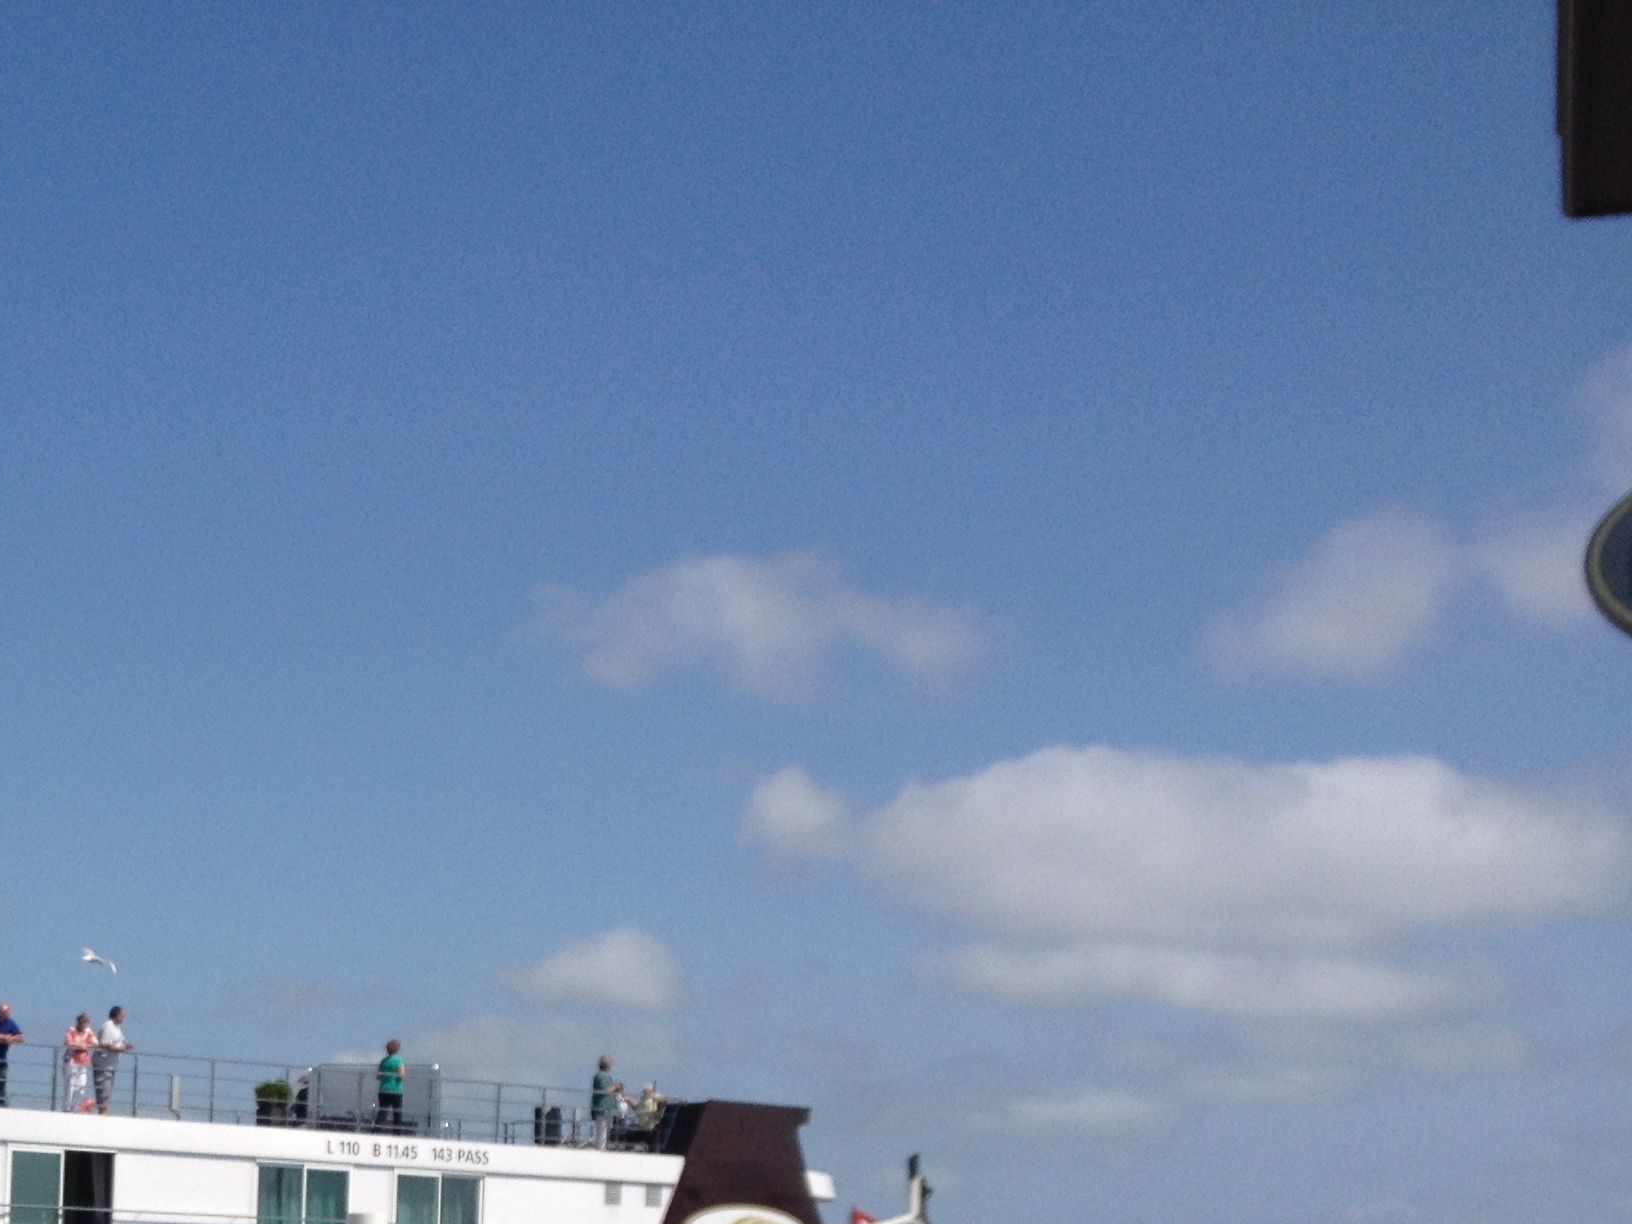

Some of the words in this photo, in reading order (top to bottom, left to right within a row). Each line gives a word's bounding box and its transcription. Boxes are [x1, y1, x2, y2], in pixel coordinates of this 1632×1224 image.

[326, 1140, 334, 1155] L
[339, 1142, 360, 1156] 110
[372, 1143, 381, 1158] B
[432, 1147, 453, 1162] 143
[457, 1149, 490, 1165] PASS
